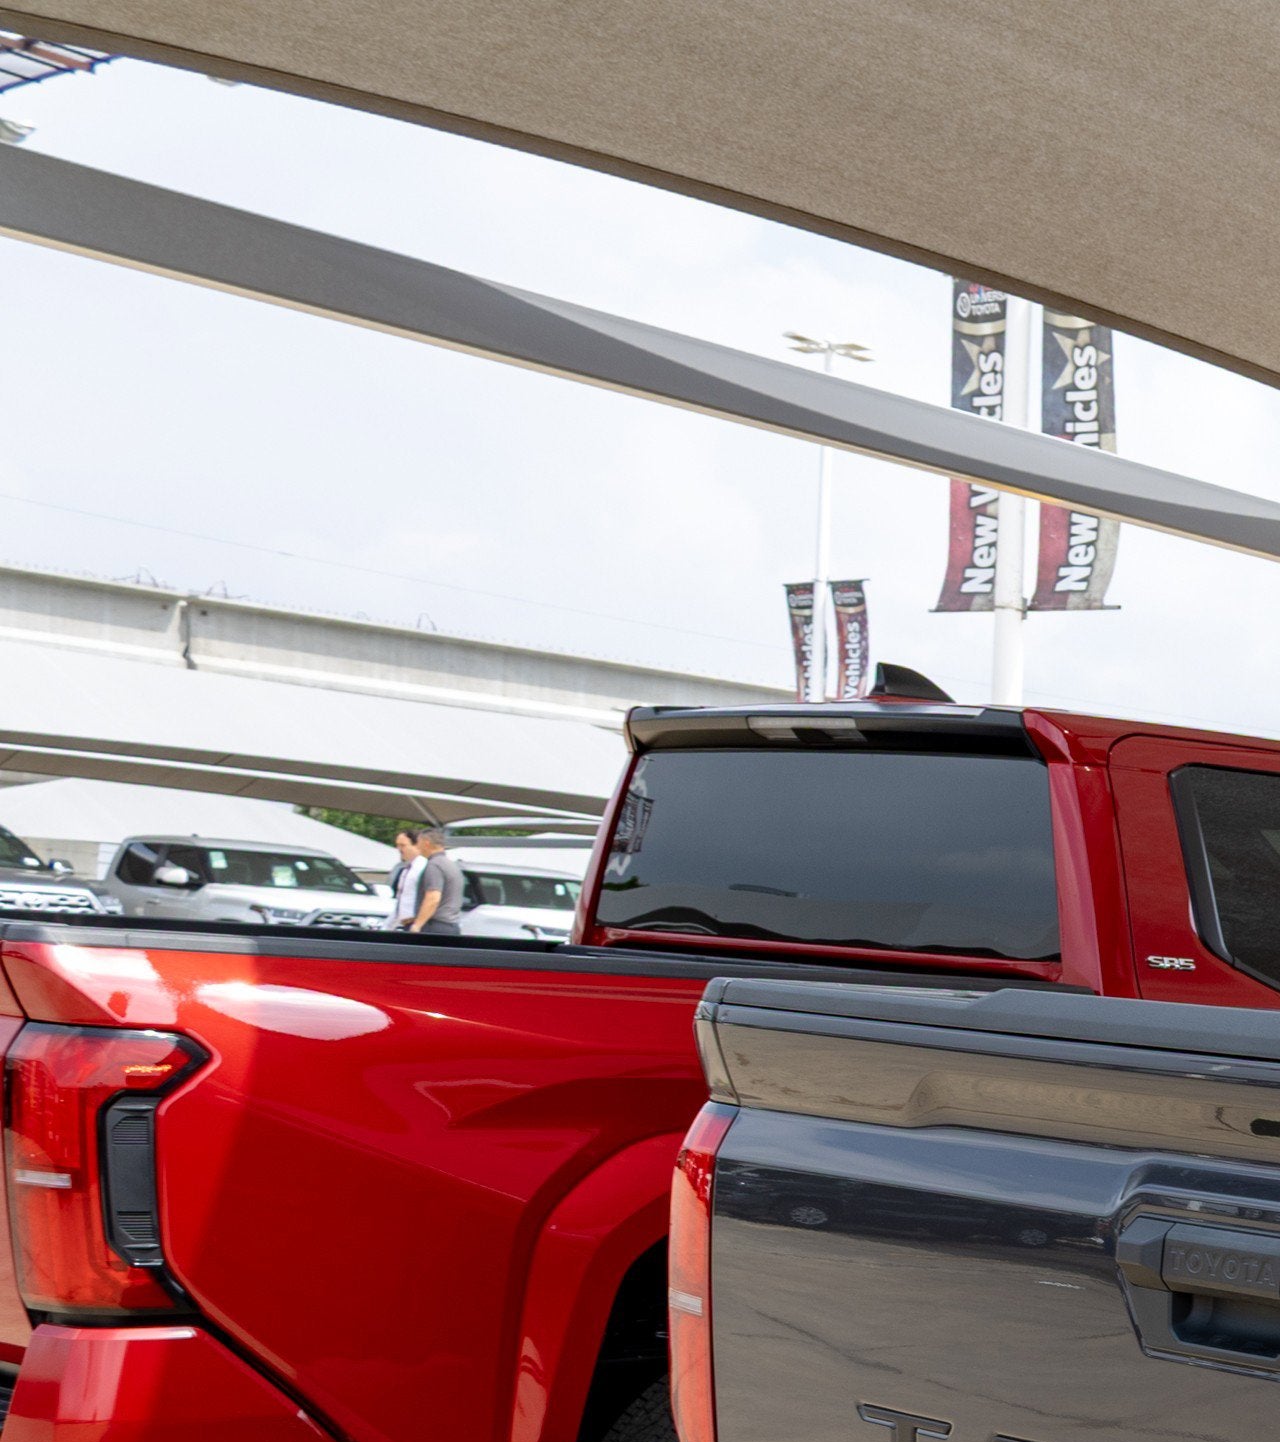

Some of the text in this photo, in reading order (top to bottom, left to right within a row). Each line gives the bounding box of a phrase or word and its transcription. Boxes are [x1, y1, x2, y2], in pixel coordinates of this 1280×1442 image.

[971, 303, 1001, 316] TOYOTA
[960, 514, 998, 593] New
[1054, 512, 1099, 592] New
[1146, 955, 1197, 971] SR5
[1170, 1249, 1277, 1288] TOYOTA
